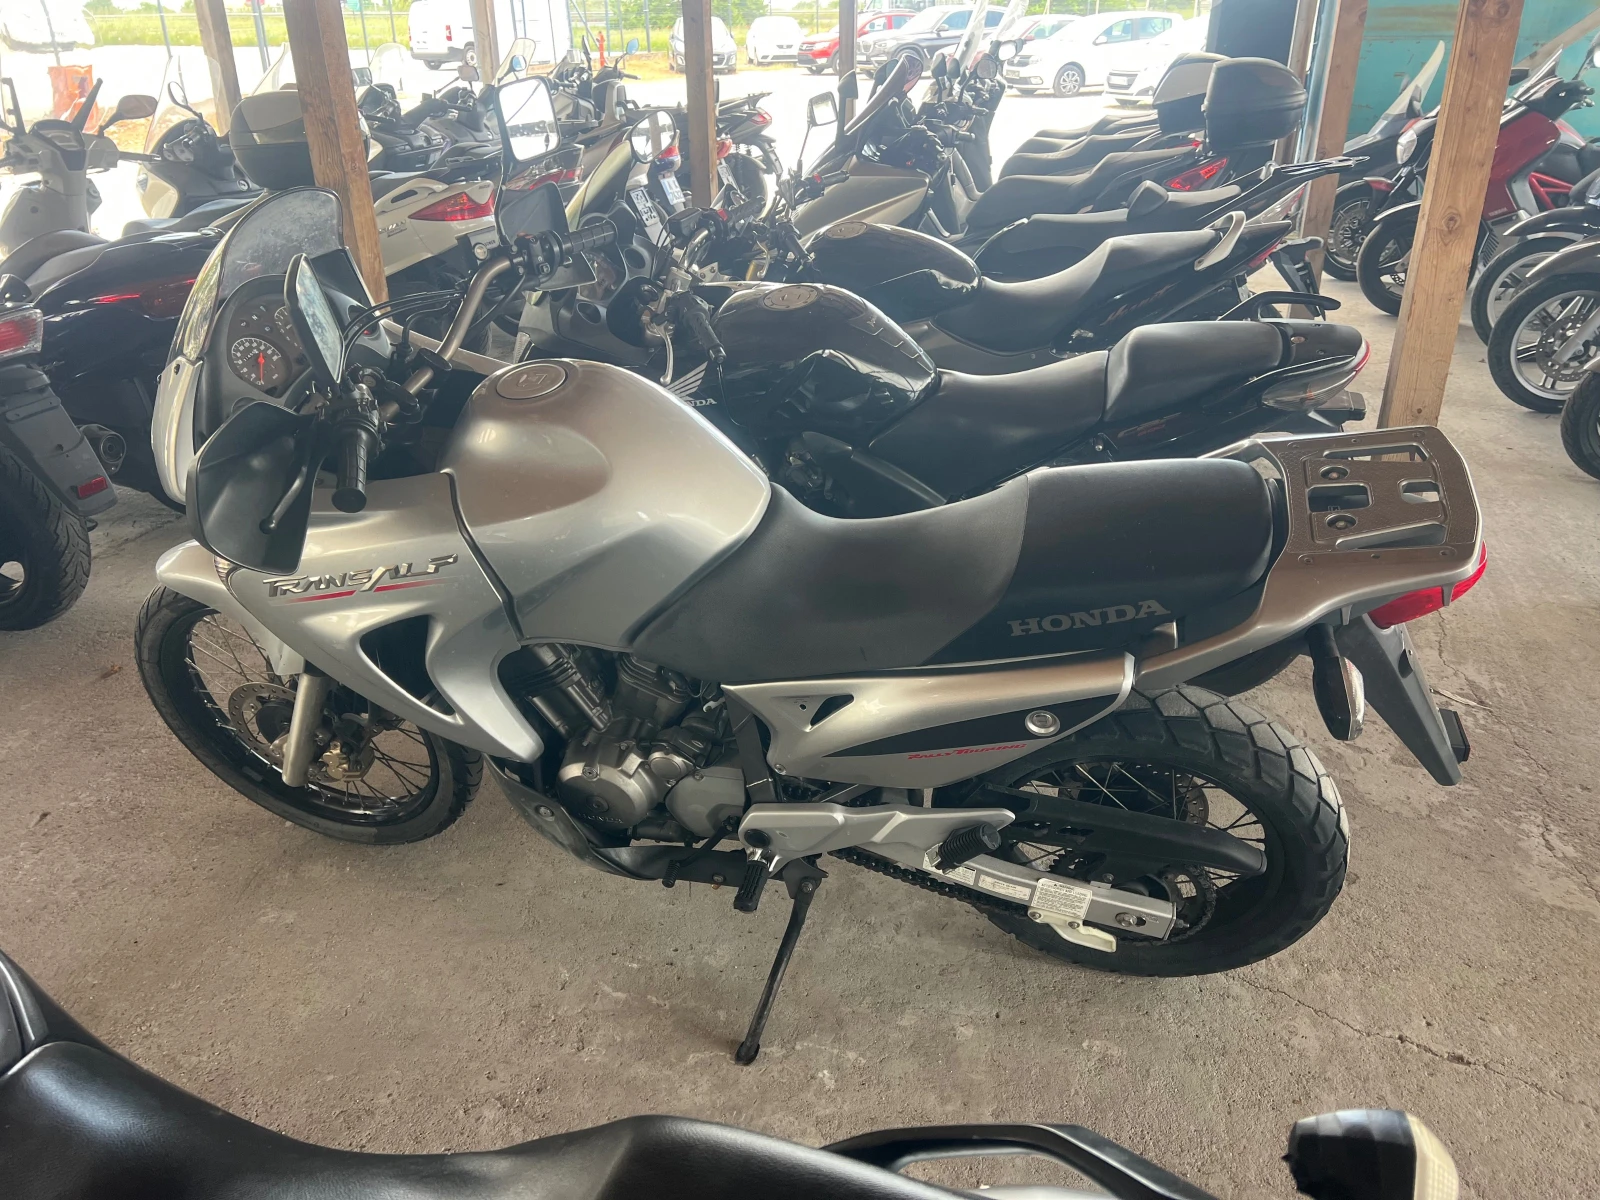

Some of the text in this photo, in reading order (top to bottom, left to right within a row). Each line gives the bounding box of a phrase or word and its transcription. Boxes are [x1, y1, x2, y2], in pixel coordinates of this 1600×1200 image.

[687, 398, 717, 407] NDA
[262, 553, 459, 597] TRANSALP
[1007, 599, 1171, 637] HONDA
